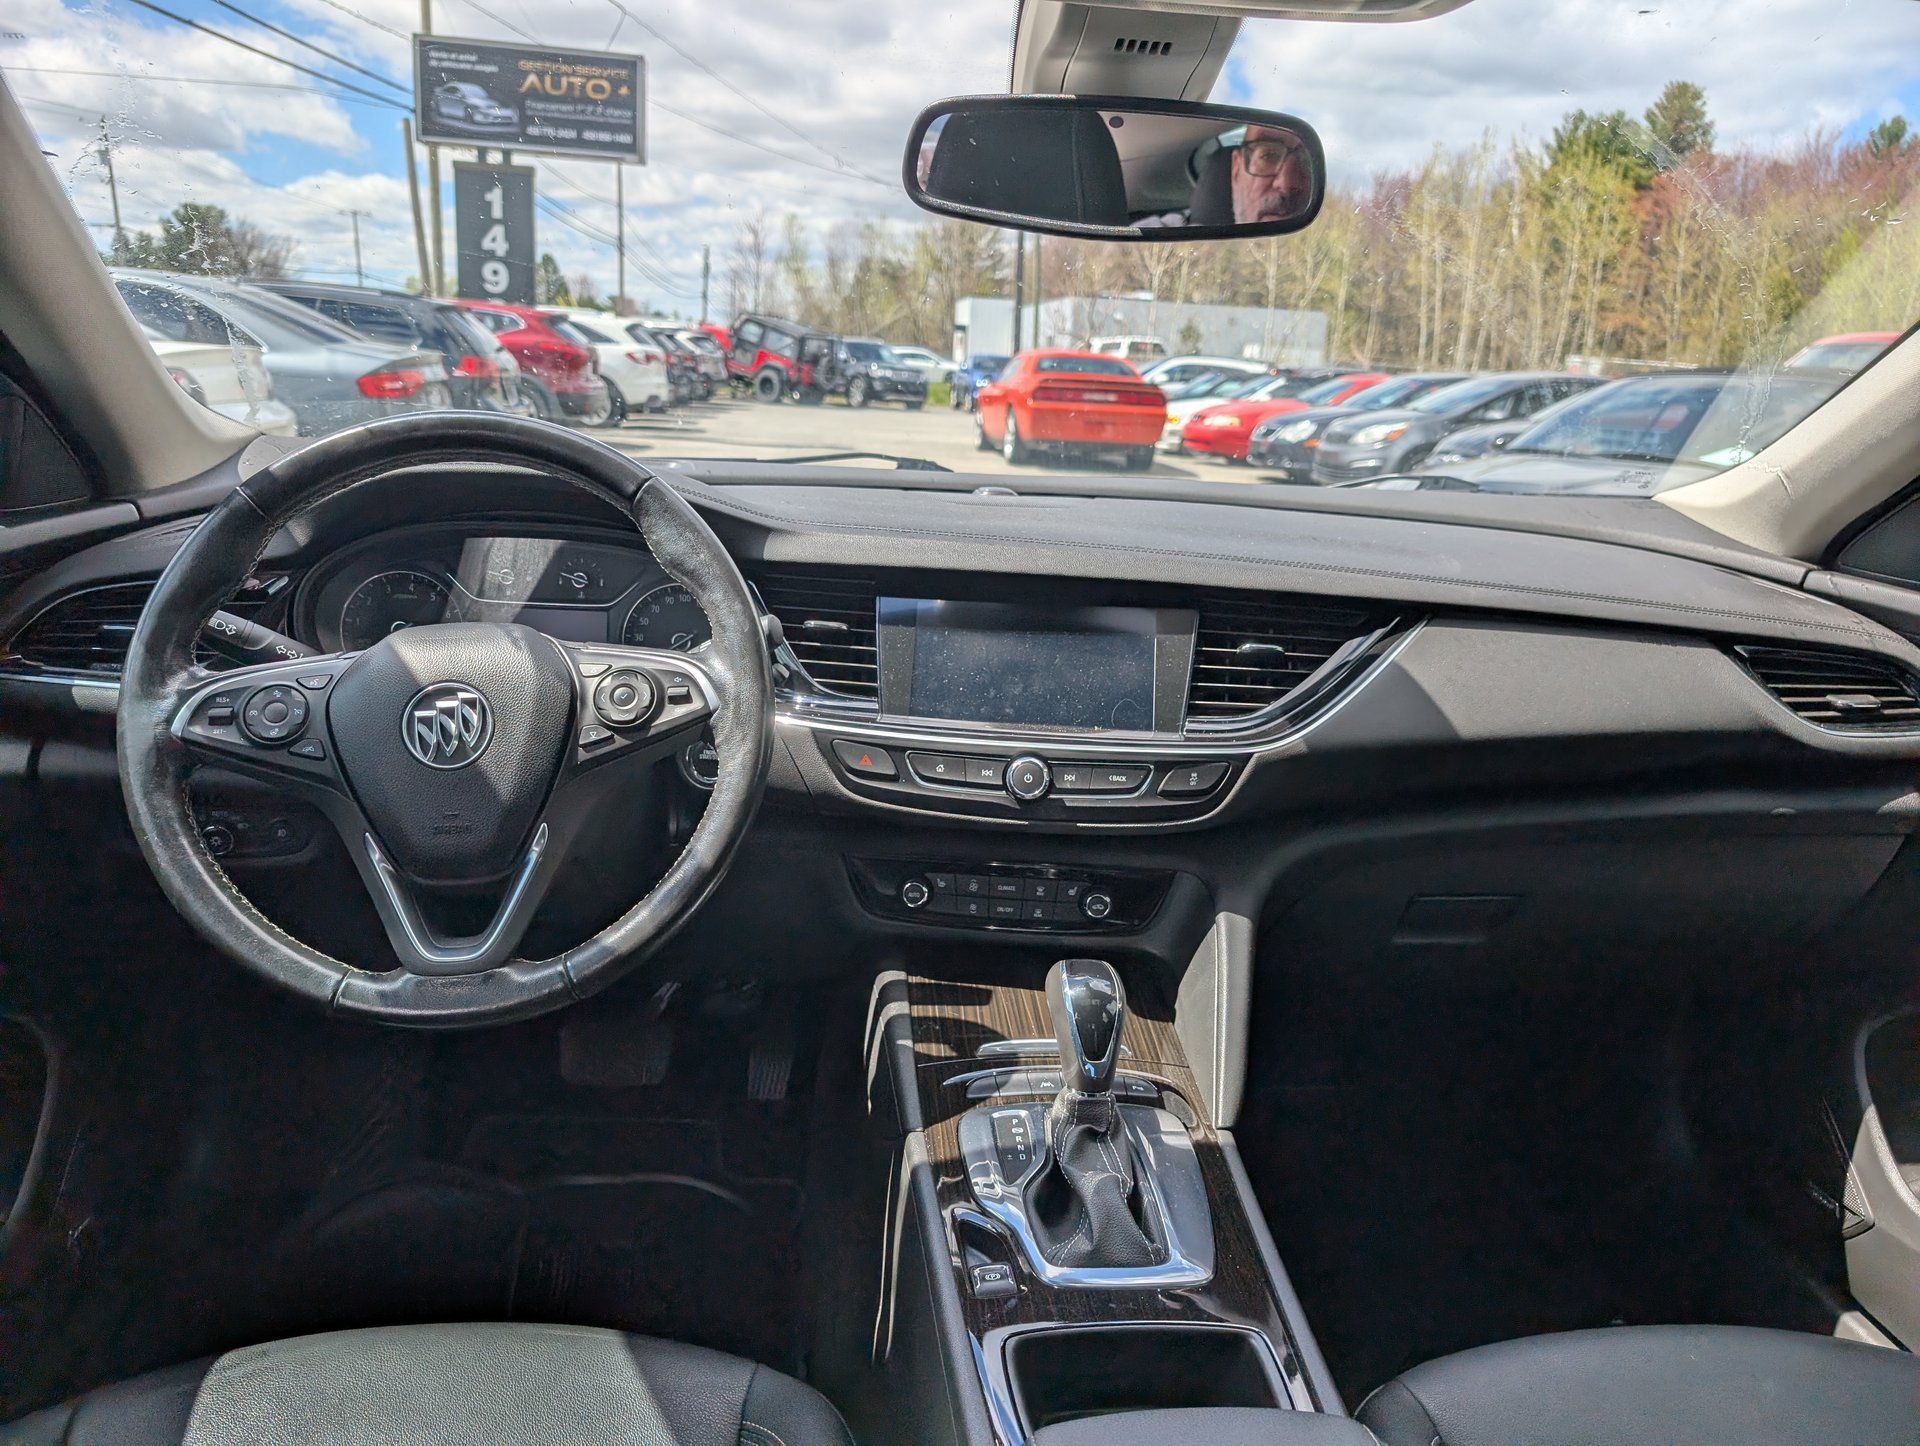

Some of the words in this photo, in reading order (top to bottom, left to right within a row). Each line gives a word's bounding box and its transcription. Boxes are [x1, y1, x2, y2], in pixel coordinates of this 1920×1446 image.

[519, 72, 612, 100] AUTO
[480, 186, 510, 304] 149
[665, 596, 675, 605] 90
[651, 605, 660, 613] 70
[640, 618, 649, 626] 50
